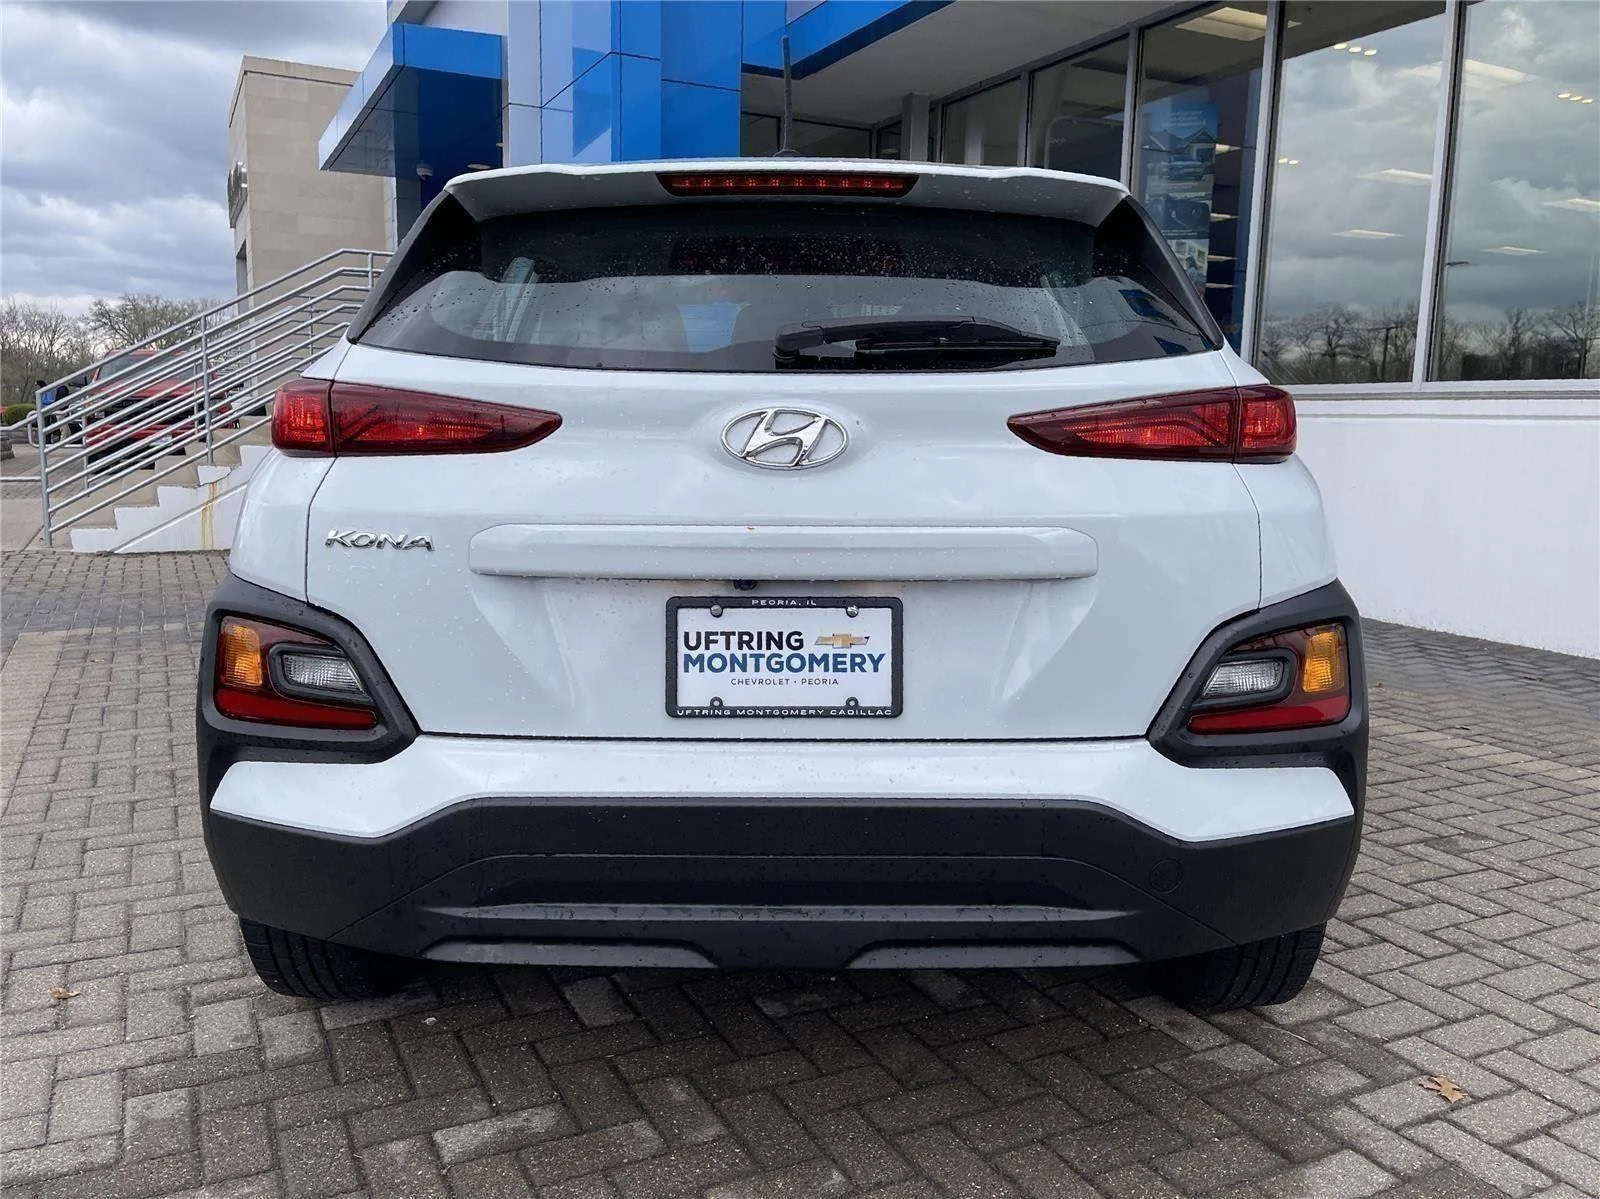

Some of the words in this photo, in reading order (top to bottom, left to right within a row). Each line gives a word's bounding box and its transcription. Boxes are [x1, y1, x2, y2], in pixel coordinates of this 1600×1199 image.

[324, 529, 435, 551] KONA
[683, 631, 804, 651] UFTRING
[683, 652, 886, 673] MONTGOMERY
[730, 678, 790, 686] CHEVROLET
[801, 678, 839, 686] PEORIA
